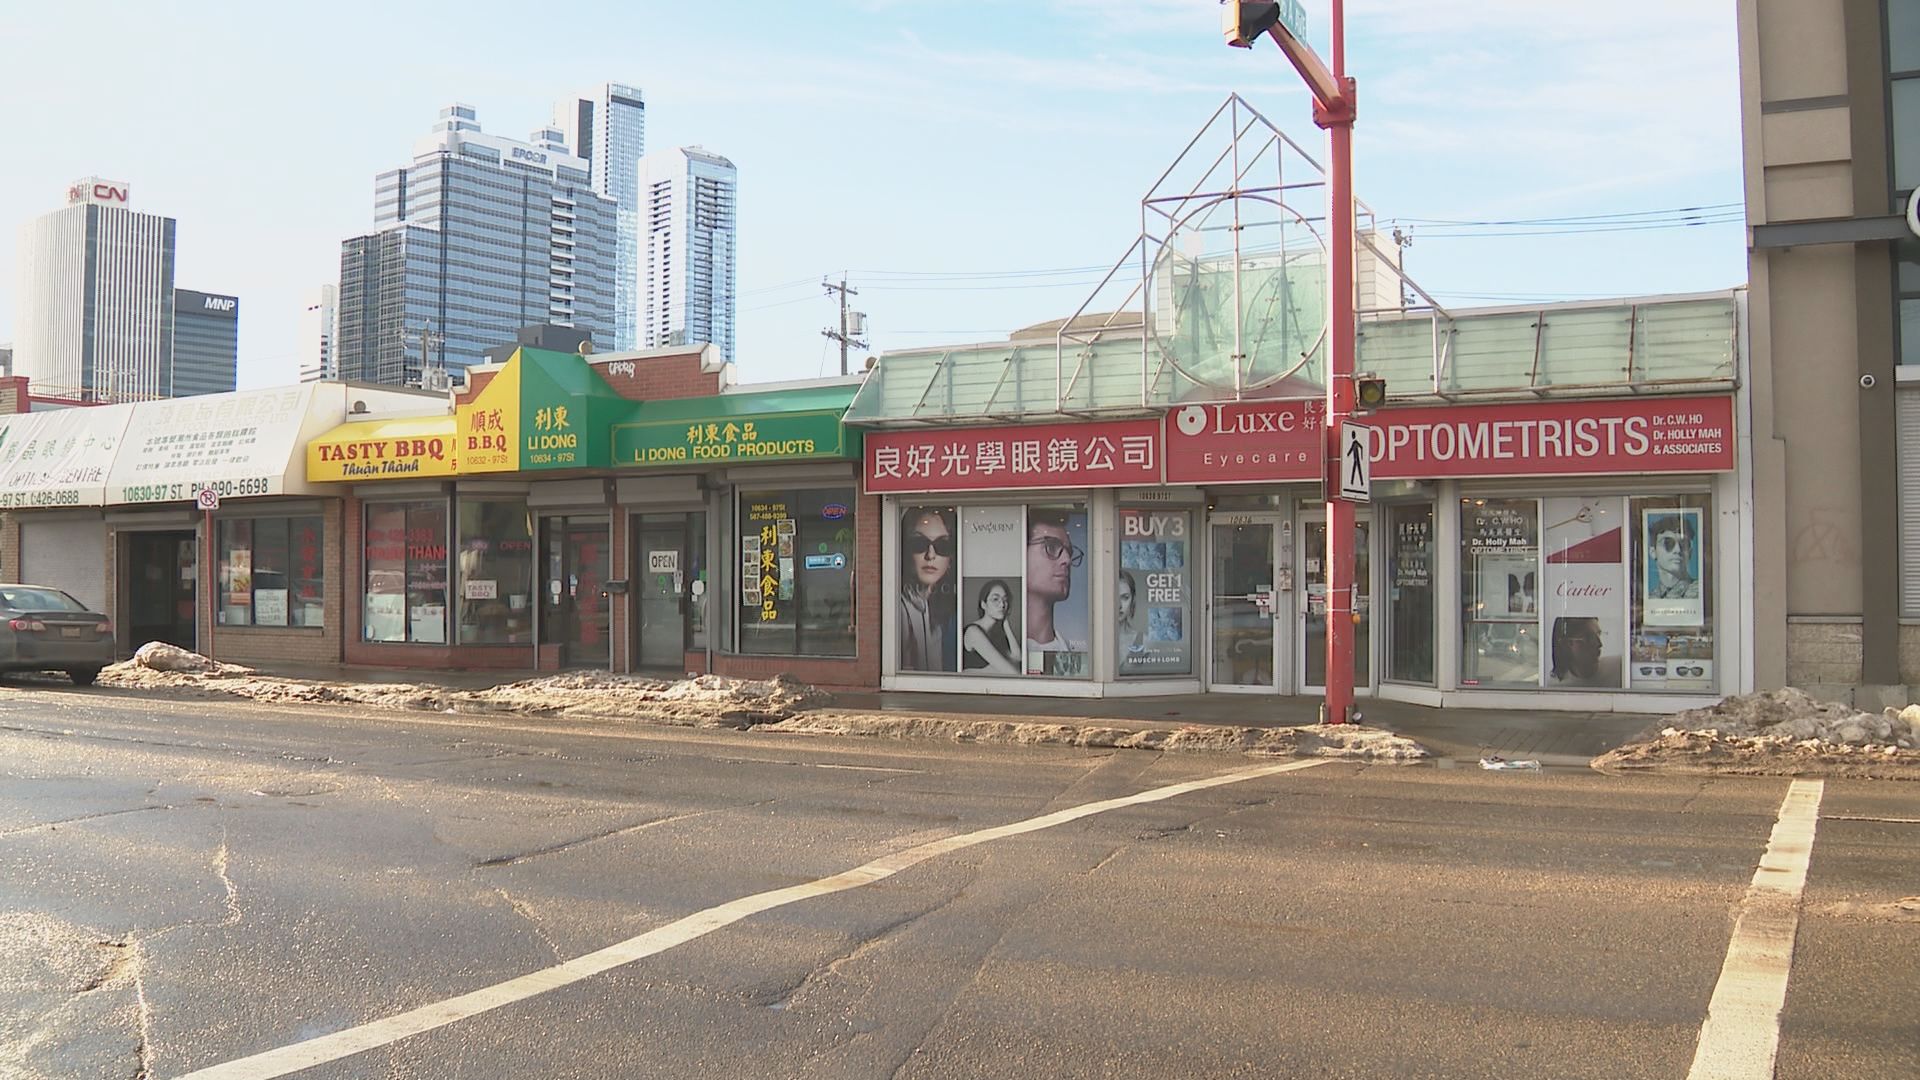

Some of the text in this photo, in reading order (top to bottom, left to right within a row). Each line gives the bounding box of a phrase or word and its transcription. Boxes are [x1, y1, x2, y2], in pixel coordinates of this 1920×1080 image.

[512, 147, 547, 164] EPCOR
[94, 184, 127, 202] CN
[204, 297, 235, 311] MNP
[471, 408, 504, 432] 順成
[535, 406, 570, 431] 利東
[1213, 404, 1295, 434] Luxe
[1653, 416, 1666, 426] Dr.
[1689, 414, 1703, 424] HO
[528, 433, 577, 450] LI DONG
[686, 422, 757, 445] 利東食品
[1369, 416, 1649, 463] OPTOMETRISTS
[1653, 428, 1722, 440] Dr. HOLLY MAH
[318, 442, 388, 462] TASTY
[395, 438, 445, 460] BBQ
[468, 434, 507, 452] B.B.Q
[634, 440, 815, 462] LI DONG FOOD PRODUCTS
[1653, 443, 1722, 455] & ASSOCIATES
[873, 435, 1154, 480] 良好光學眼鏡公司
[1204, 451, 1308, 467] Eyecare
[382, 458, 419, 475] Thành
[123, 484, 168, 502] 10630-97
[190, 478, 269, 498] PH990-6698
[1125, 516, 1185, 536] BUY 3
[1472, 538, 1484, 546] Dr.
[1485, 538, 1507, 547] Holly
[652, 556, 675, 568] OPEN
[760, 524, 778, 621] 利東食品
[1147, 573, 1175, 588] GET
[1147, 589, 1180, 602] FREE
[1556, 583, 1612, 597] Cartier
